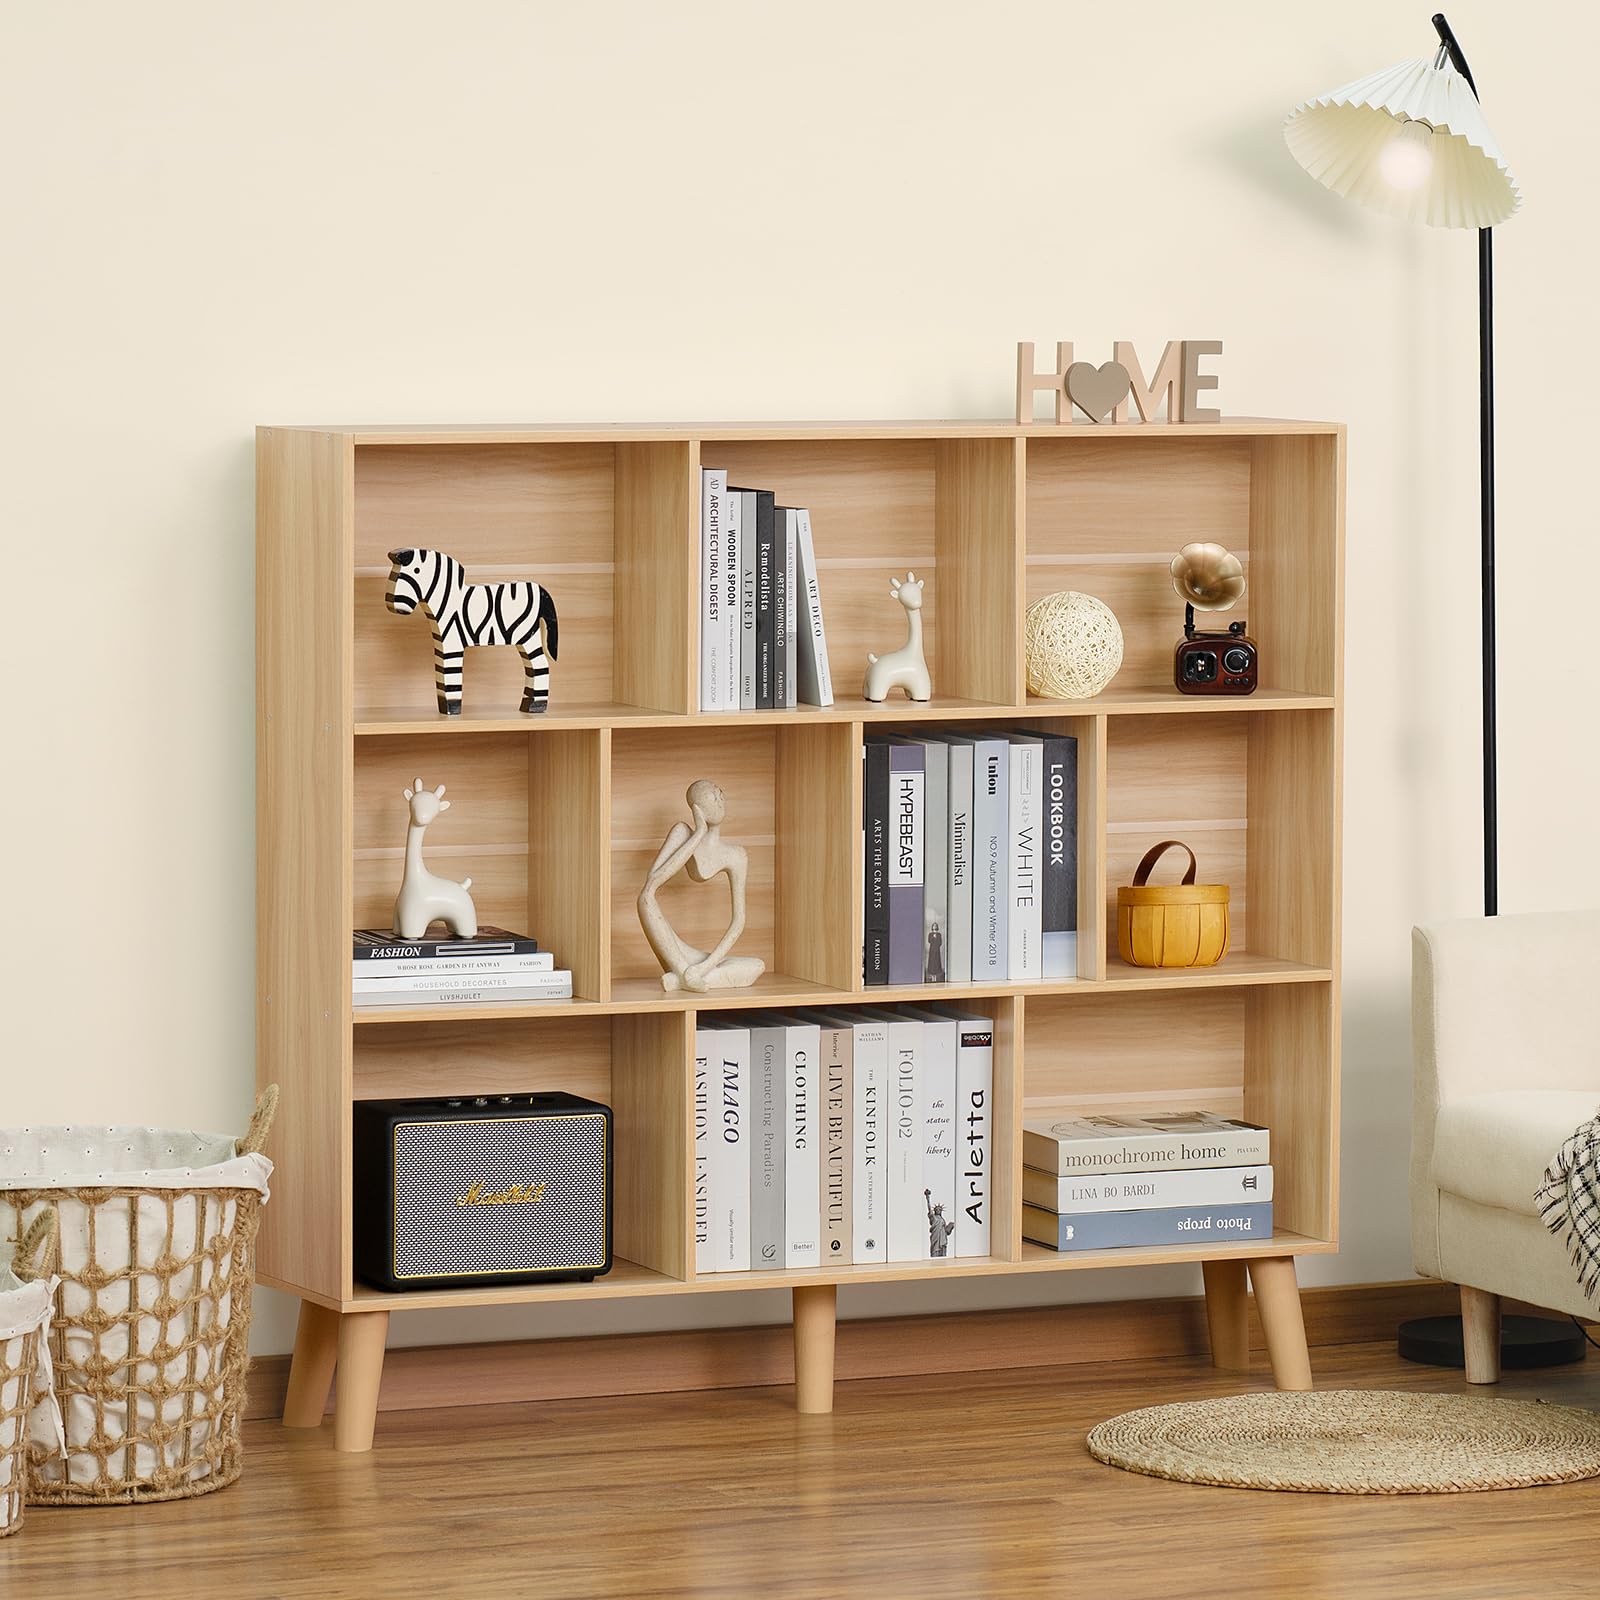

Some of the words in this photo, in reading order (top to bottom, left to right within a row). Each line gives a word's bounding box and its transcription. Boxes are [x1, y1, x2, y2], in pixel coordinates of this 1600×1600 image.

[710, 477, 719, 489] AD
[710, 495, 718, 581] ARCHITECTURAL
[727, 529, 736, 570] WOODEN
[727, 574, 736, 606] SPOON
[761, 543, 770, 611] Remodelista
[808, 578, 818, 601] ART
[709, 584, 718, 622] DIGEST
[744, 569, 753, 630] ALPRED
[811, 606, 822, 638] DECO
[988, 756, 999, 795] Union
[899, 779, 913, 878] HYPEBEAST
[1050, 764, 1063, 865] LOOKBOOK
[954, 813, 966, 886] Minimalista
[989, 836, 997, 857] NO.9
[989, 860, 997, 893] Autumn
[1017, 826, 1033, 907] WHITE
[988, 896, 997, 913] and
[988, 915, 997, 941] Winter
[370, 946, 421, 958] FASHION
[988, 944, 997, 966] 2018
[440, 993, 481, 1001] LIVSHJULET
[462, 979, 507, 987] DECORATES
[723, 1059, 739, 1143] IMAGO
[763, 1045, 774, 1126] Constructing
[795, 1051, 806, 1150] CLOTHING
[828, 1064, 842, 1109] LIVE
[899, 1049, 914, 1139] FOLIO-02
[926, 1116, 950, 1124] statue
[932, 1100, 944, 1108] the
[866, 1087, 876, 1166] KINFOLK
[933, 1131, 943, 1142] of
[763, 1133, 774, 1187] Paradies
[926, 1147, 951, 1157] liberty
[964, 1089, 984, 1224] Arletta
[1066, 1148, 1175, 1167] monochrome
[1181, 1144, 1226, 1160] home
[828, 1117, 843, 1229] BEAUTIFUL
[1071, 1188, 1098, 1200] LINA
[1104, 1186, 1117, 1198] BO
[1123, 1184, 1155, 1197] BARDI
[1177, 1216, 1211, 1231] props
[1216, 1218, 1252, 1230] Photo
